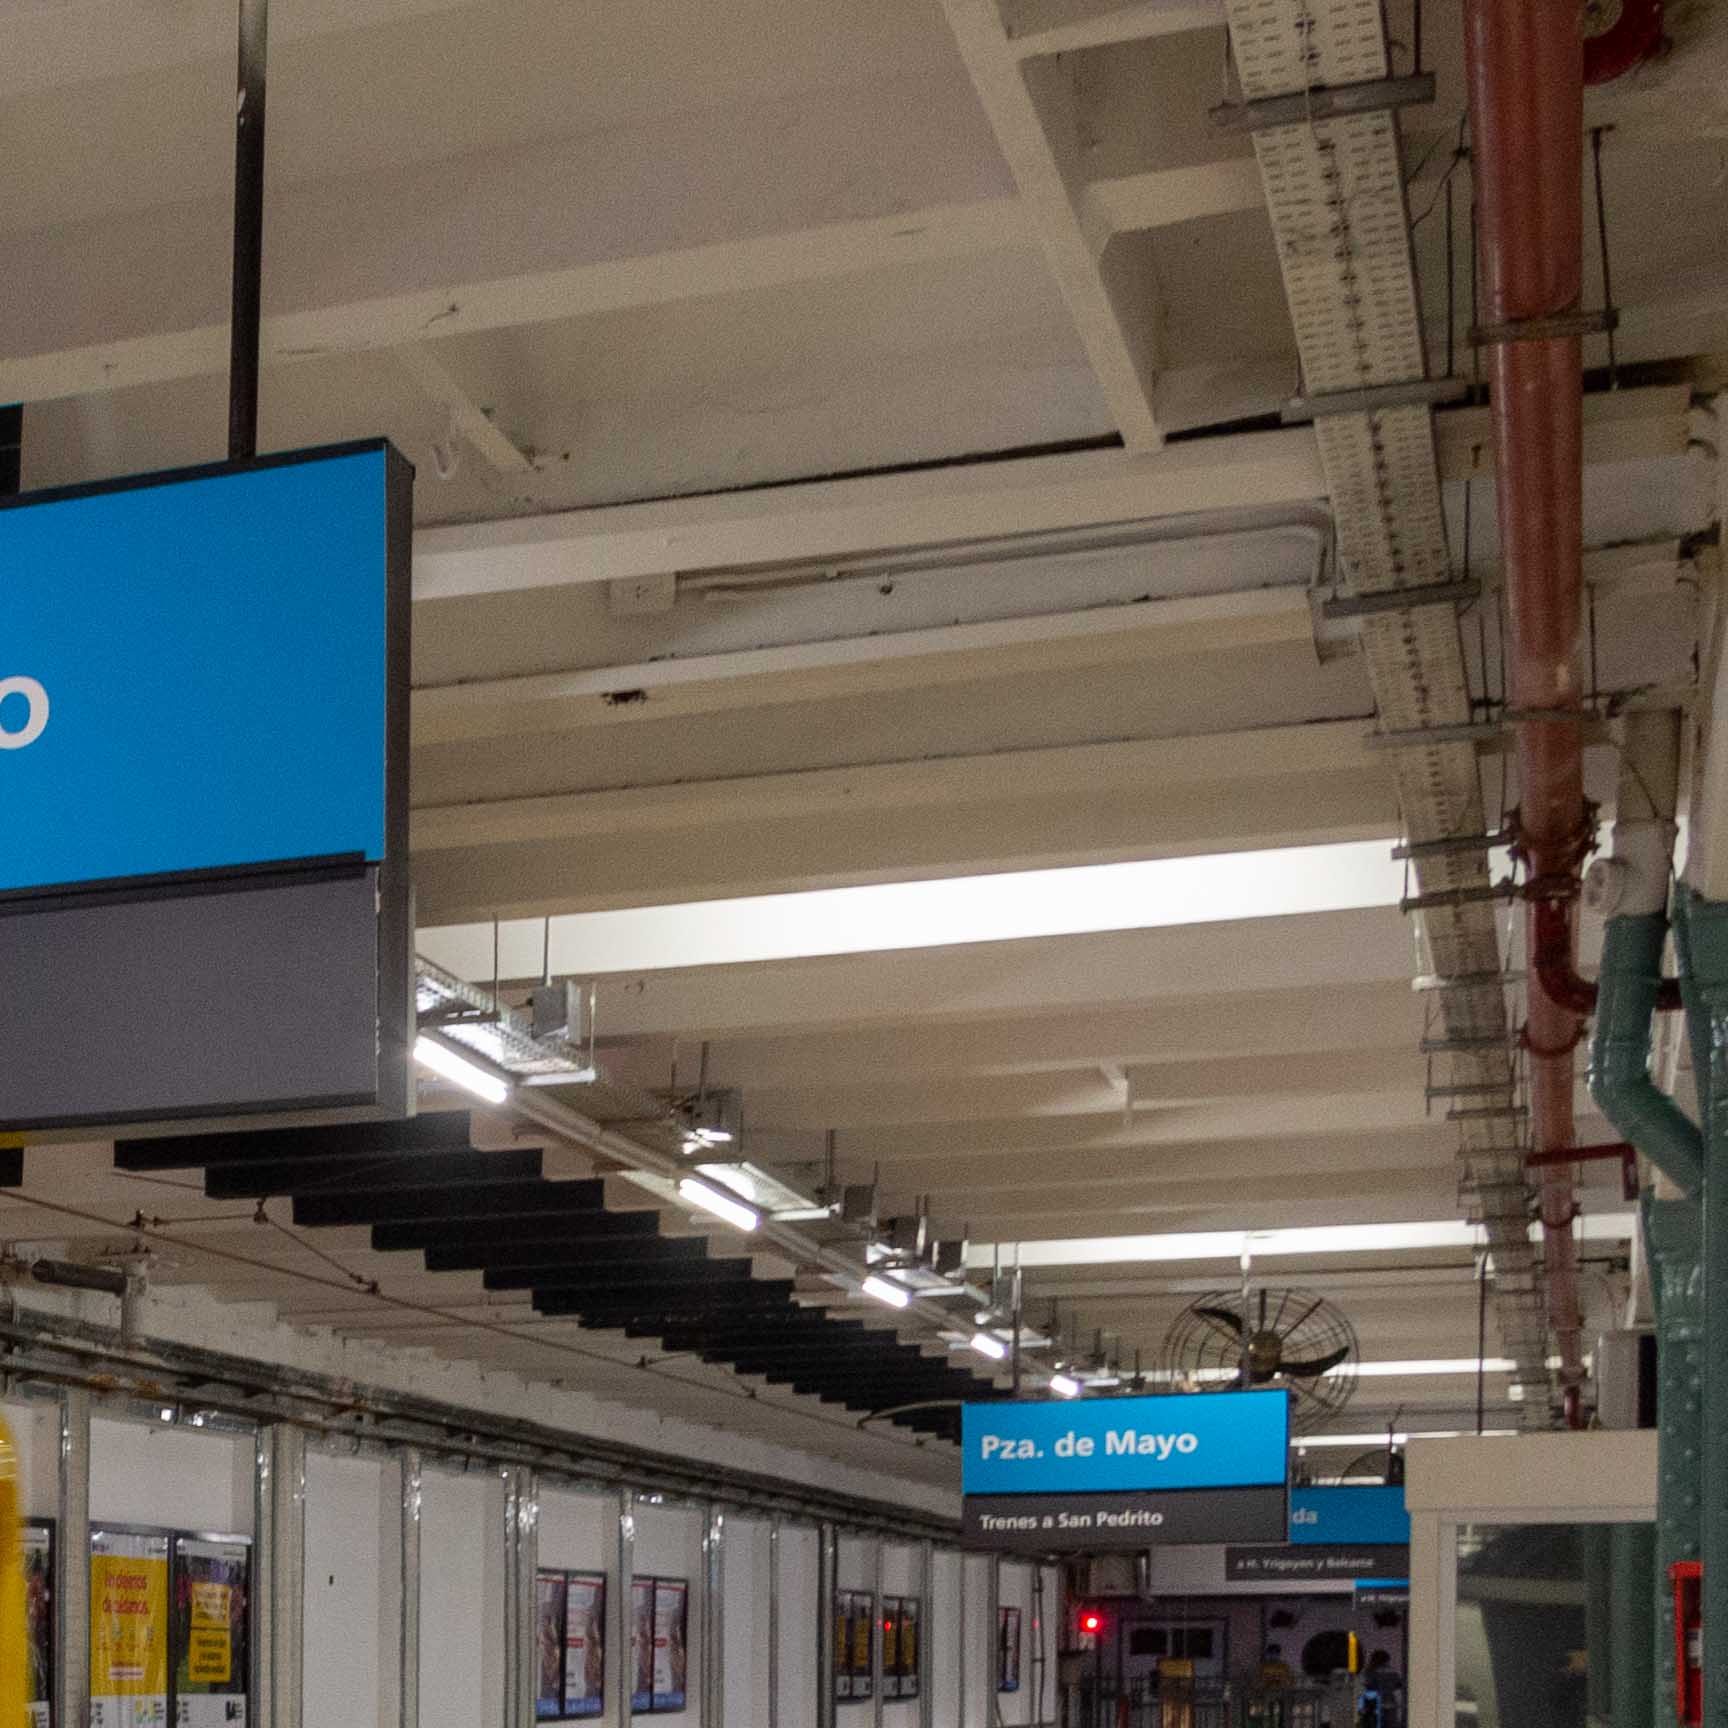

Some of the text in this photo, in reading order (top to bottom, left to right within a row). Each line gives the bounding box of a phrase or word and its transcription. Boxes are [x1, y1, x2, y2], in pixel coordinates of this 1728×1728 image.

[980, 1429, 1199, 1461] Pza. de Mayo
[979, 1508, 1164, 1530] Trenes a San Pedrito
[1292, 1508, 1318, 1524] da
